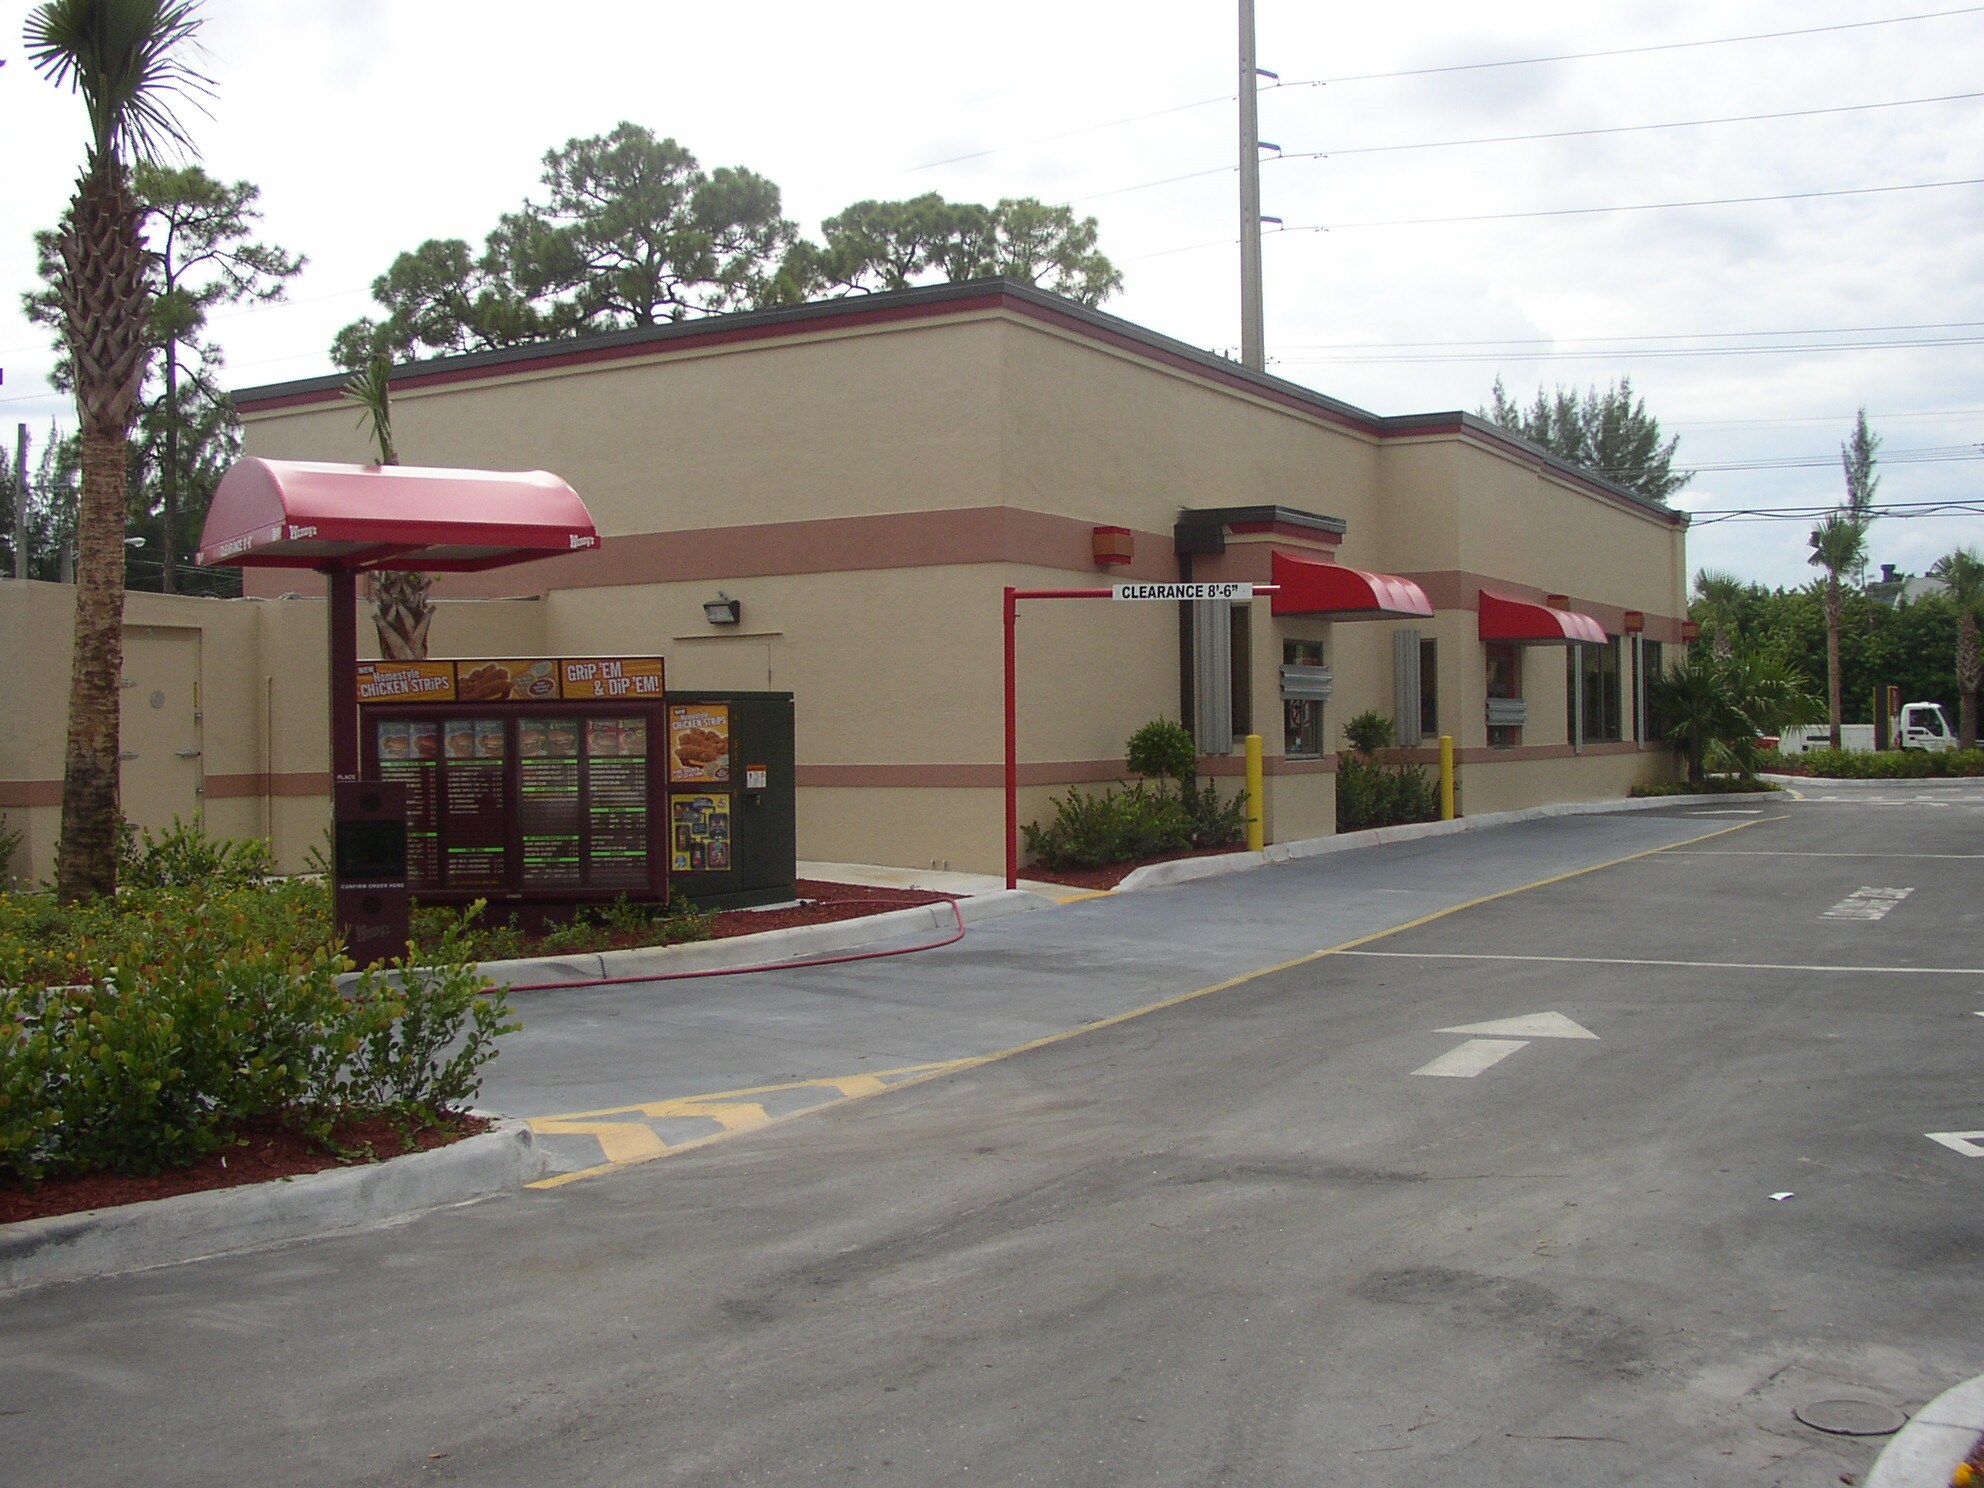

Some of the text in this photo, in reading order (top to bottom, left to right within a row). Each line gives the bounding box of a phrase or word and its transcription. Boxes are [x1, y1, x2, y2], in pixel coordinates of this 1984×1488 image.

[1122, 584, 1239, 599] CLEARANCE 8'-6"
[373, 668, 420, 683] Homestyle
[599, 662, 622, 678] 'EM
[594, 680, 605, 695] &
[633, 675, 660, 692] 'EM!
